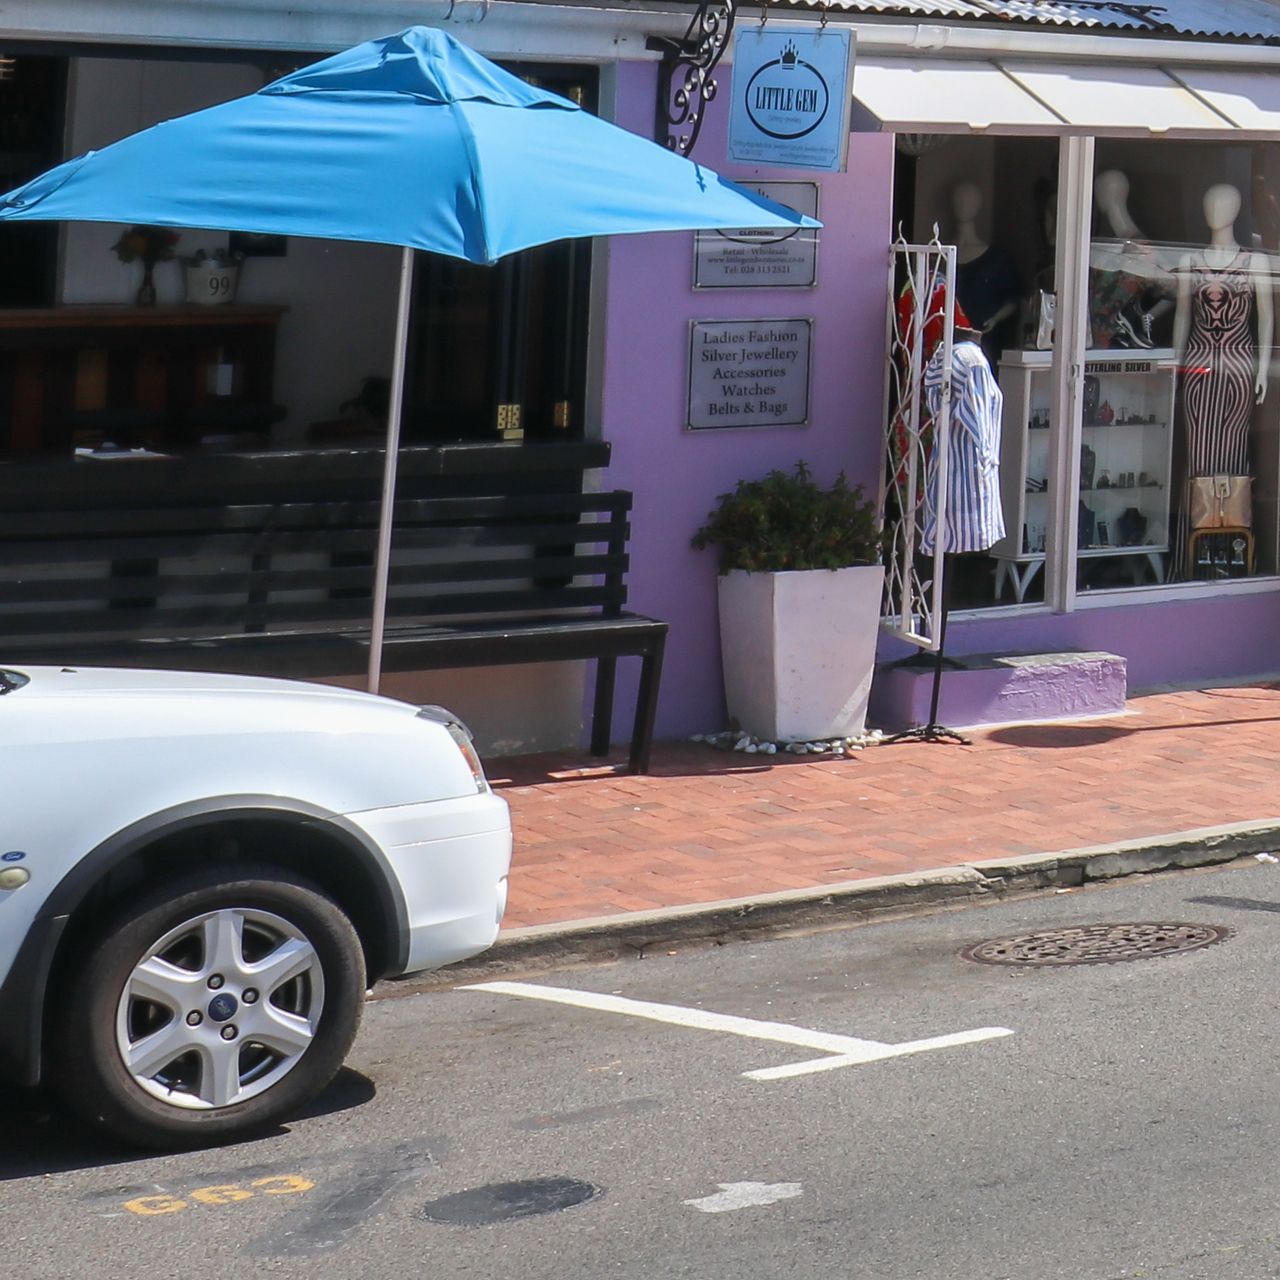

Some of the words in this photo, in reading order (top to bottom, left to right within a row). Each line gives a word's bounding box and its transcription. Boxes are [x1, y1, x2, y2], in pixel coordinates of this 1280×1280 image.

[755, 86, 794, 112] LITTLE
[795, 88, 818, 113] GEM
[703, 330, 745, 345] Ladies
[748, 329, 798, 343] Fashion
[701, 348, 738, 363] Silver
[738, 346, 799, 365] Jewellery
[712, 366, 787, 380] Accessories
[1084, 361, 1122, 373] STERLING
[1125, 361, 1151, 373] SILVER
[722, 382, 777, 397] Watches
[708, 401, 740, 416] Belts
[743, 401, 755, 414] &
[759, 400, 788, 417] Bags
